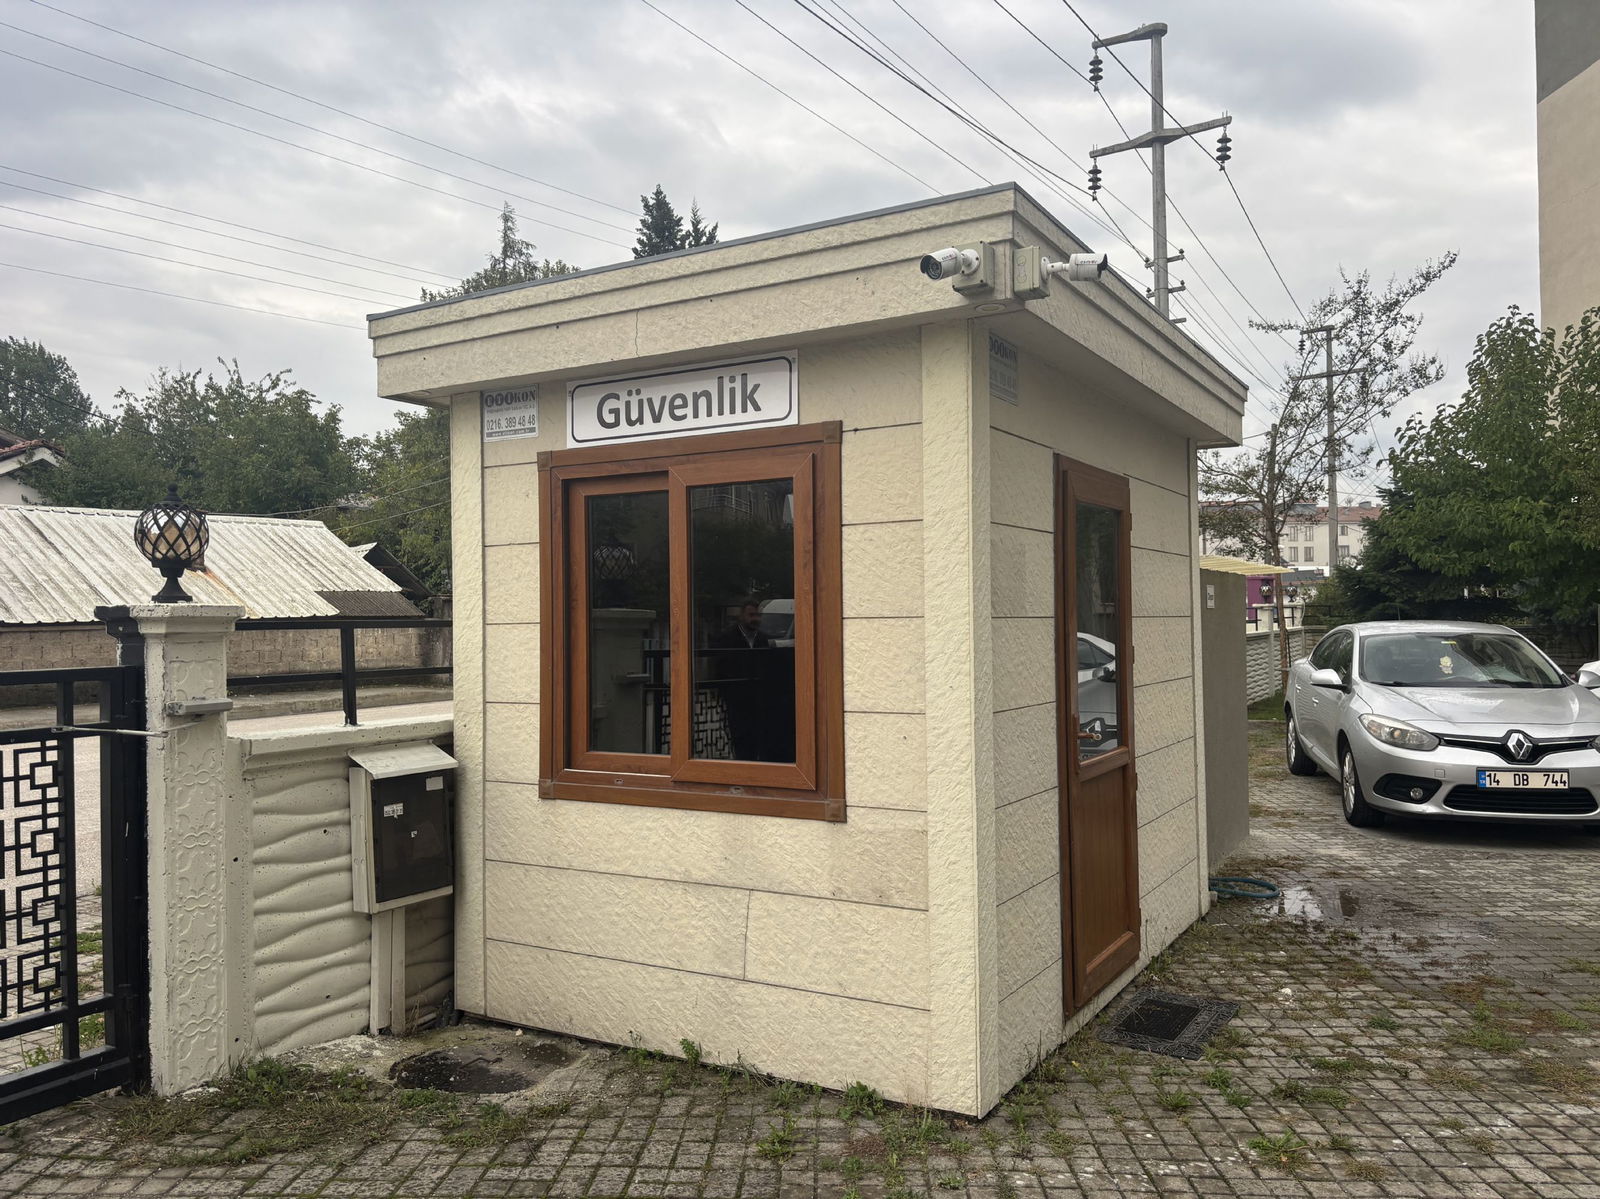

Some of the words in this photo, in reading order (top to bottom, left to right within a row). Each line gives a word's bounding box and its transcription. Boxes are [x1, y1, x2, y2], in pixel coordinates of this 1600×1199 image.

[597, 373, 761, 429] Güvenlik
[505, 416, 517, 429] 389
[518, 415, 526, 427] 48
[528, 414, 536, 426] 48
[1486, 773, 1500, 786] 14
[1513, 773, 1529, 786] DB
[1543, 774, 1567, 787] 744
